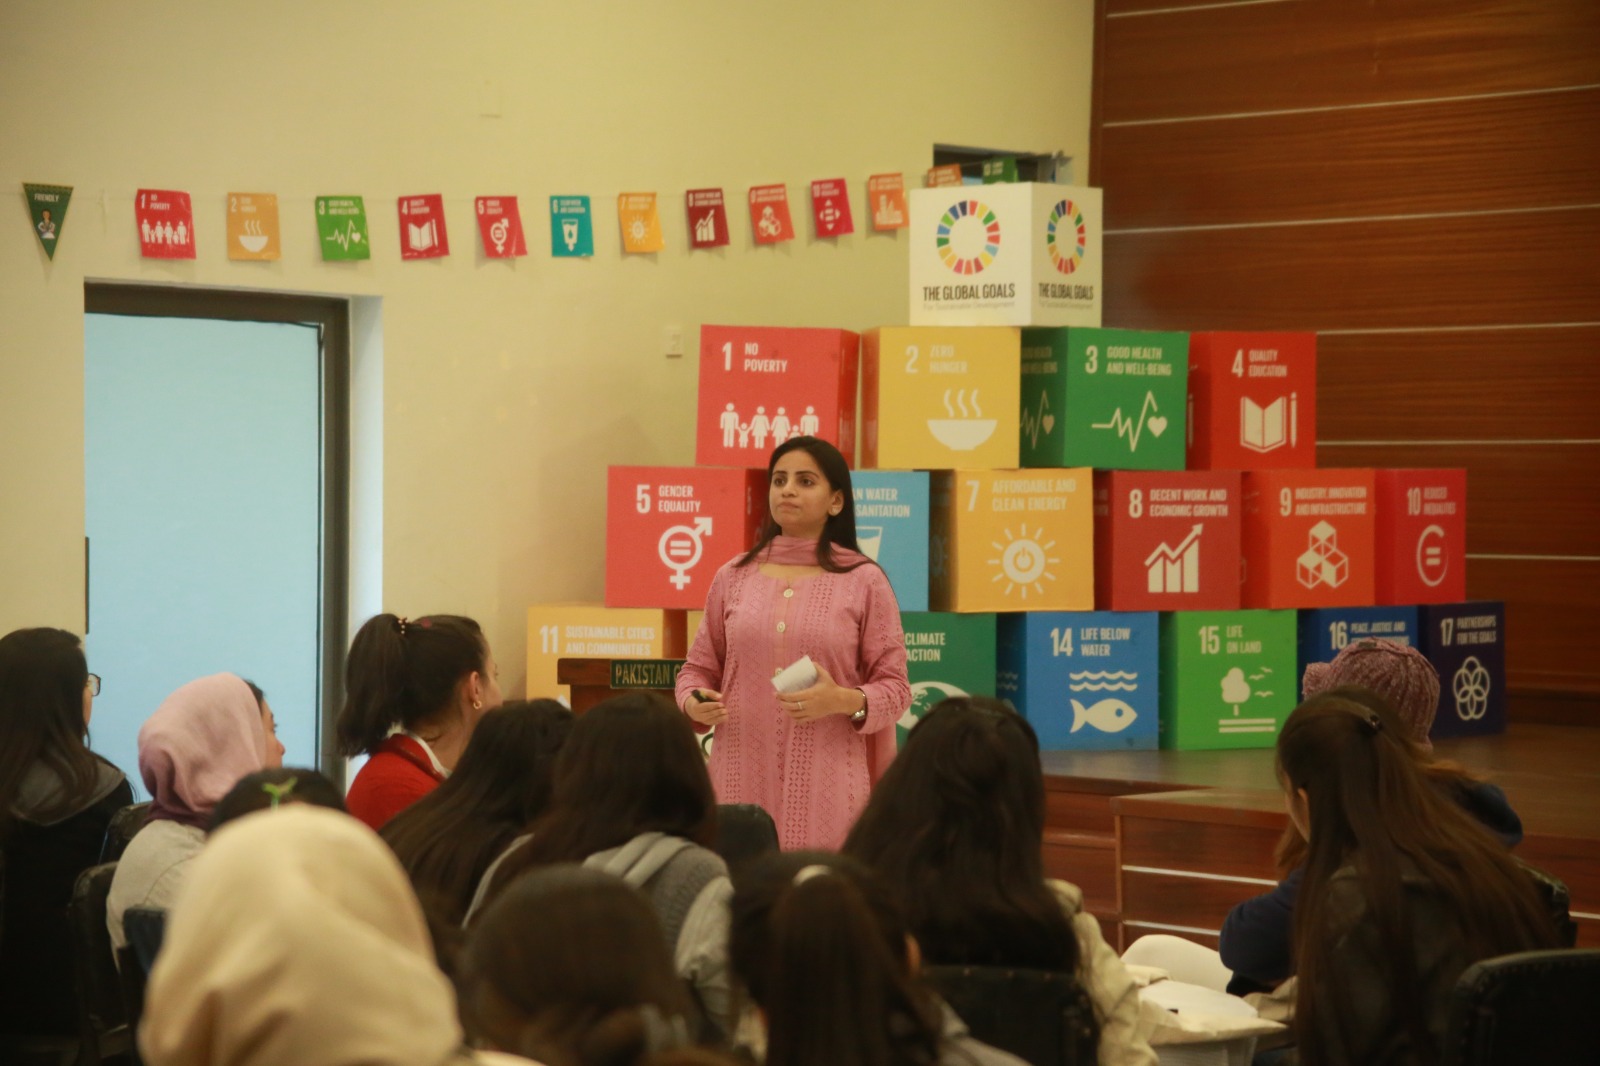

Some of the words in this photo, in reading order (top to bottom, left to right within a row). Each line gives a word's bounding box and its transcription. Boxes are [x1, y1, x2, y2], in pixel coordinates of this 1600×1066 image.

[34, 193, 59, 202] FRIENDLY
[141, 193, 146, 209] 1
[231, 197, 237, 213] 2
[319, 200, 325, 215] 3
[402, 200, 408, 215] 4
[478, 199, 484, 215] 5
[922, 286, 940, 301] THE
[942, 285, 980, 300] GLOBAL
[982, 283, 1015, 299] GOALS
[1038, 282, 1050, 297] THE
[1050, 283, 1073, 299] GLOBAL
[1074, 285, 1094, 300] GOALS
[744, 343, 758, 355] NO
[929, 345, 954, 357] ZERO
[1106, 346, 1130, 358] GOOD
[1131, 346, 1162, 360] HEALTH
[1249, 349, 1278, 362] QUALITY
[722, 342, 732, 371] 1
[905, 345, 919, 374] 2
[1085, 345, 1098, 374] 3
[1231, 349, 1244, 378] 4
[744, 359, 788, 373] POVERTY
[929, 361, 968, 374] HUNGER
[1106, 362, 1124, 374] AND
[1125, 362, 1172, 376] WELL-BEING
[1249, 364, 1287, 377] EDUCATION
[658, 485, 693, 497] GENDER
[992, 480, 1056, 494] AFFORDABLE
[1057, 479, 1076, 493] AND
[636, 484, 651, 514] 5
[866, 488, 898, 500] WATER
[966, 480, 980, 512] 7
[1149, 489, 1181, 501] DECENT
[1183, 489, 1208, 501] WORK
[1209, 489, 1227, 501] AND
[658, 500, 700, 513] EQUALITY
[992, 498, 1025, 512] CLEAN
[1028, 497, 1067, 511] ENERGY
[1129, 489, 1142, 518] 8
[1280, 487, 1292, 516] 9
[1407, 487, 1421, 516] 10
[855, 504, 911, 517] SANITATION
[1149, 504, 1192, 517] ECONOMIC
[1193, 504, 1228, 517] GROWTH
[1457, 615, 1497, 629] PARTNERSHIPS
[566, 626, 625, 639] SUSTAINABLE
[627, 627, 655, 640] CITIES
[1081, 628, 1098, 640] LIFE
[1100, 628, 1131, 640] BELOW
[1226, 625, 1243, 638] LIFE
[1329, 621, 1347, 650] 16
[1440, 618, 1453, 646] 17
[1457, 632, 1468, 645] FOR
[1468, 632, 1478, 644] THE
[1478, 631, 1497, 643] GOALS
[540, 625, 558, 654] 11
[905, 632, 946, 646] CLIMATE
[1050, 628, 1073, 656] 14
[1199, 625, 1220, 654] 15
[566, 642, 585, 654] AND
[586, 643, 651, 656] COMMUNITIES
[906, 648, 941, 661] ACTION
[1081, 644, 1110, 656] WATER
[1226, 641, 1238, 654] ON
[1240, 641, 1262, 654] LAND
[615, 664, 670, 684] PAKISTAN
